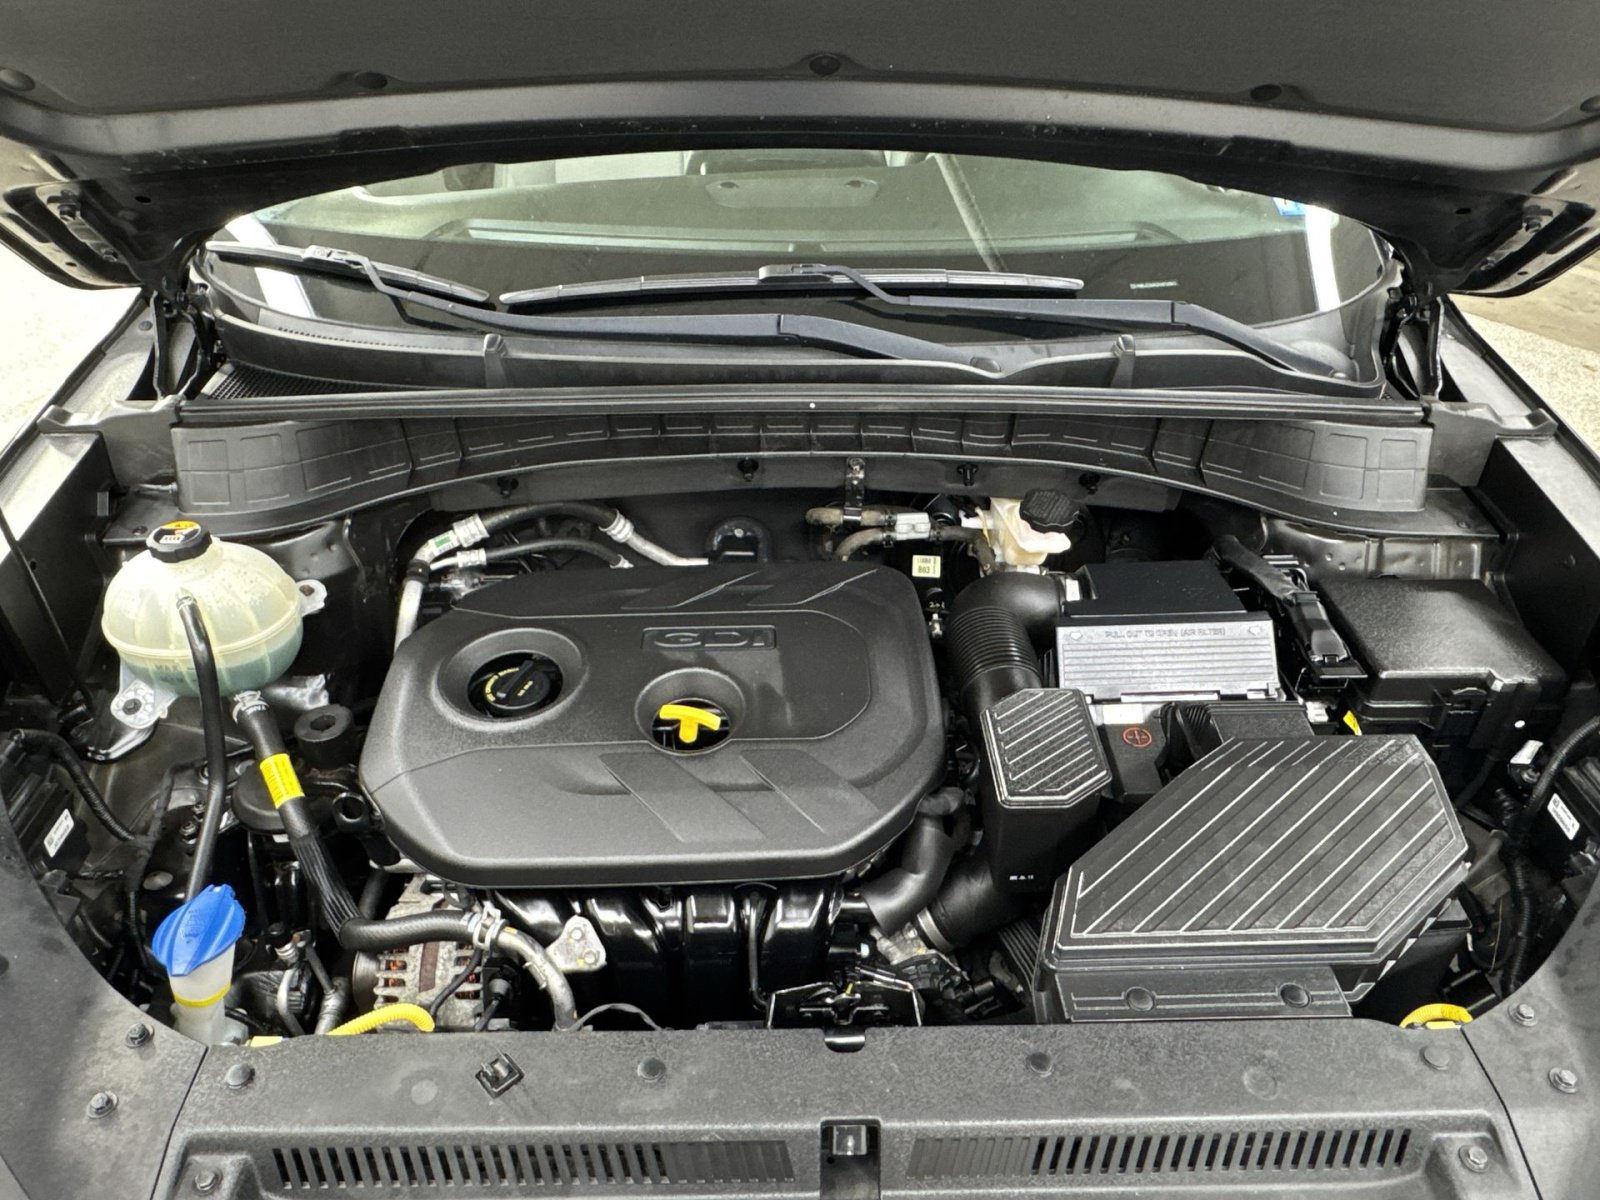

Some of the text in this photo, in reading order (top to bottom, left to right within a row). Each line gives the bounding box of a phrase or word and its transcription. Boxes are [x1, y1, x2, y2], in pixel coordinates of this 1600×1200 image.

[1104, 627, 1226, 639] PULL OUT TO OPEN (AIR FILTER)
[653, 631, 766, 648] GDI
[154, 664, 180, 673] MAX
